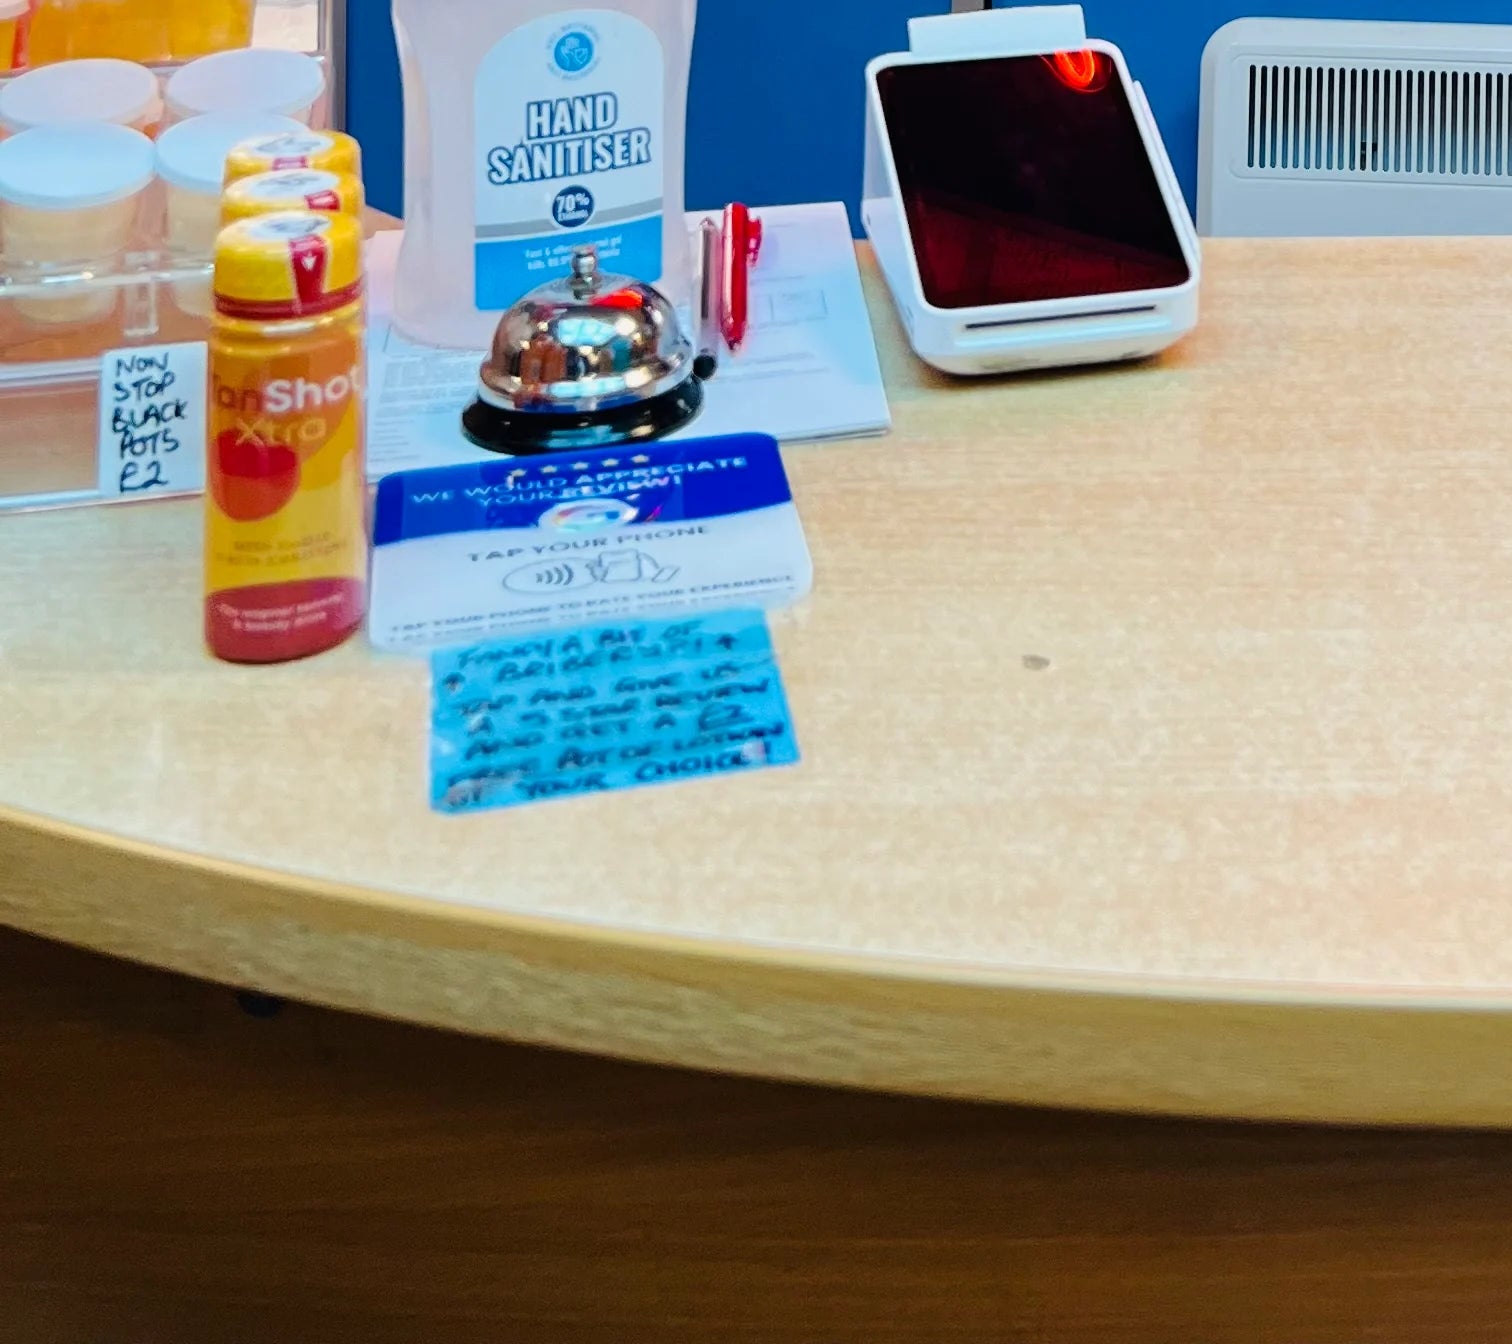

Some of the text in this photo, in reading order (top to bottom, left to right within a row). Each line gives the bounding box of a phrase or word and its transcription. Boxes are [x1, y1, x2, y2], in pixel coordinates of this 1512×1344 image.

[525, 92, 618, 142] HAND
[487, 127, 652, 186] SANITISER
[115, 352, 169, 376] NON
[113, 372, 176, 403] STOP
[111, 401, 188, 434] BLACK
[575, 456, 748, 488] APPRECIATE
[468, 525, 710, 563] TAP YOUR PHONE
